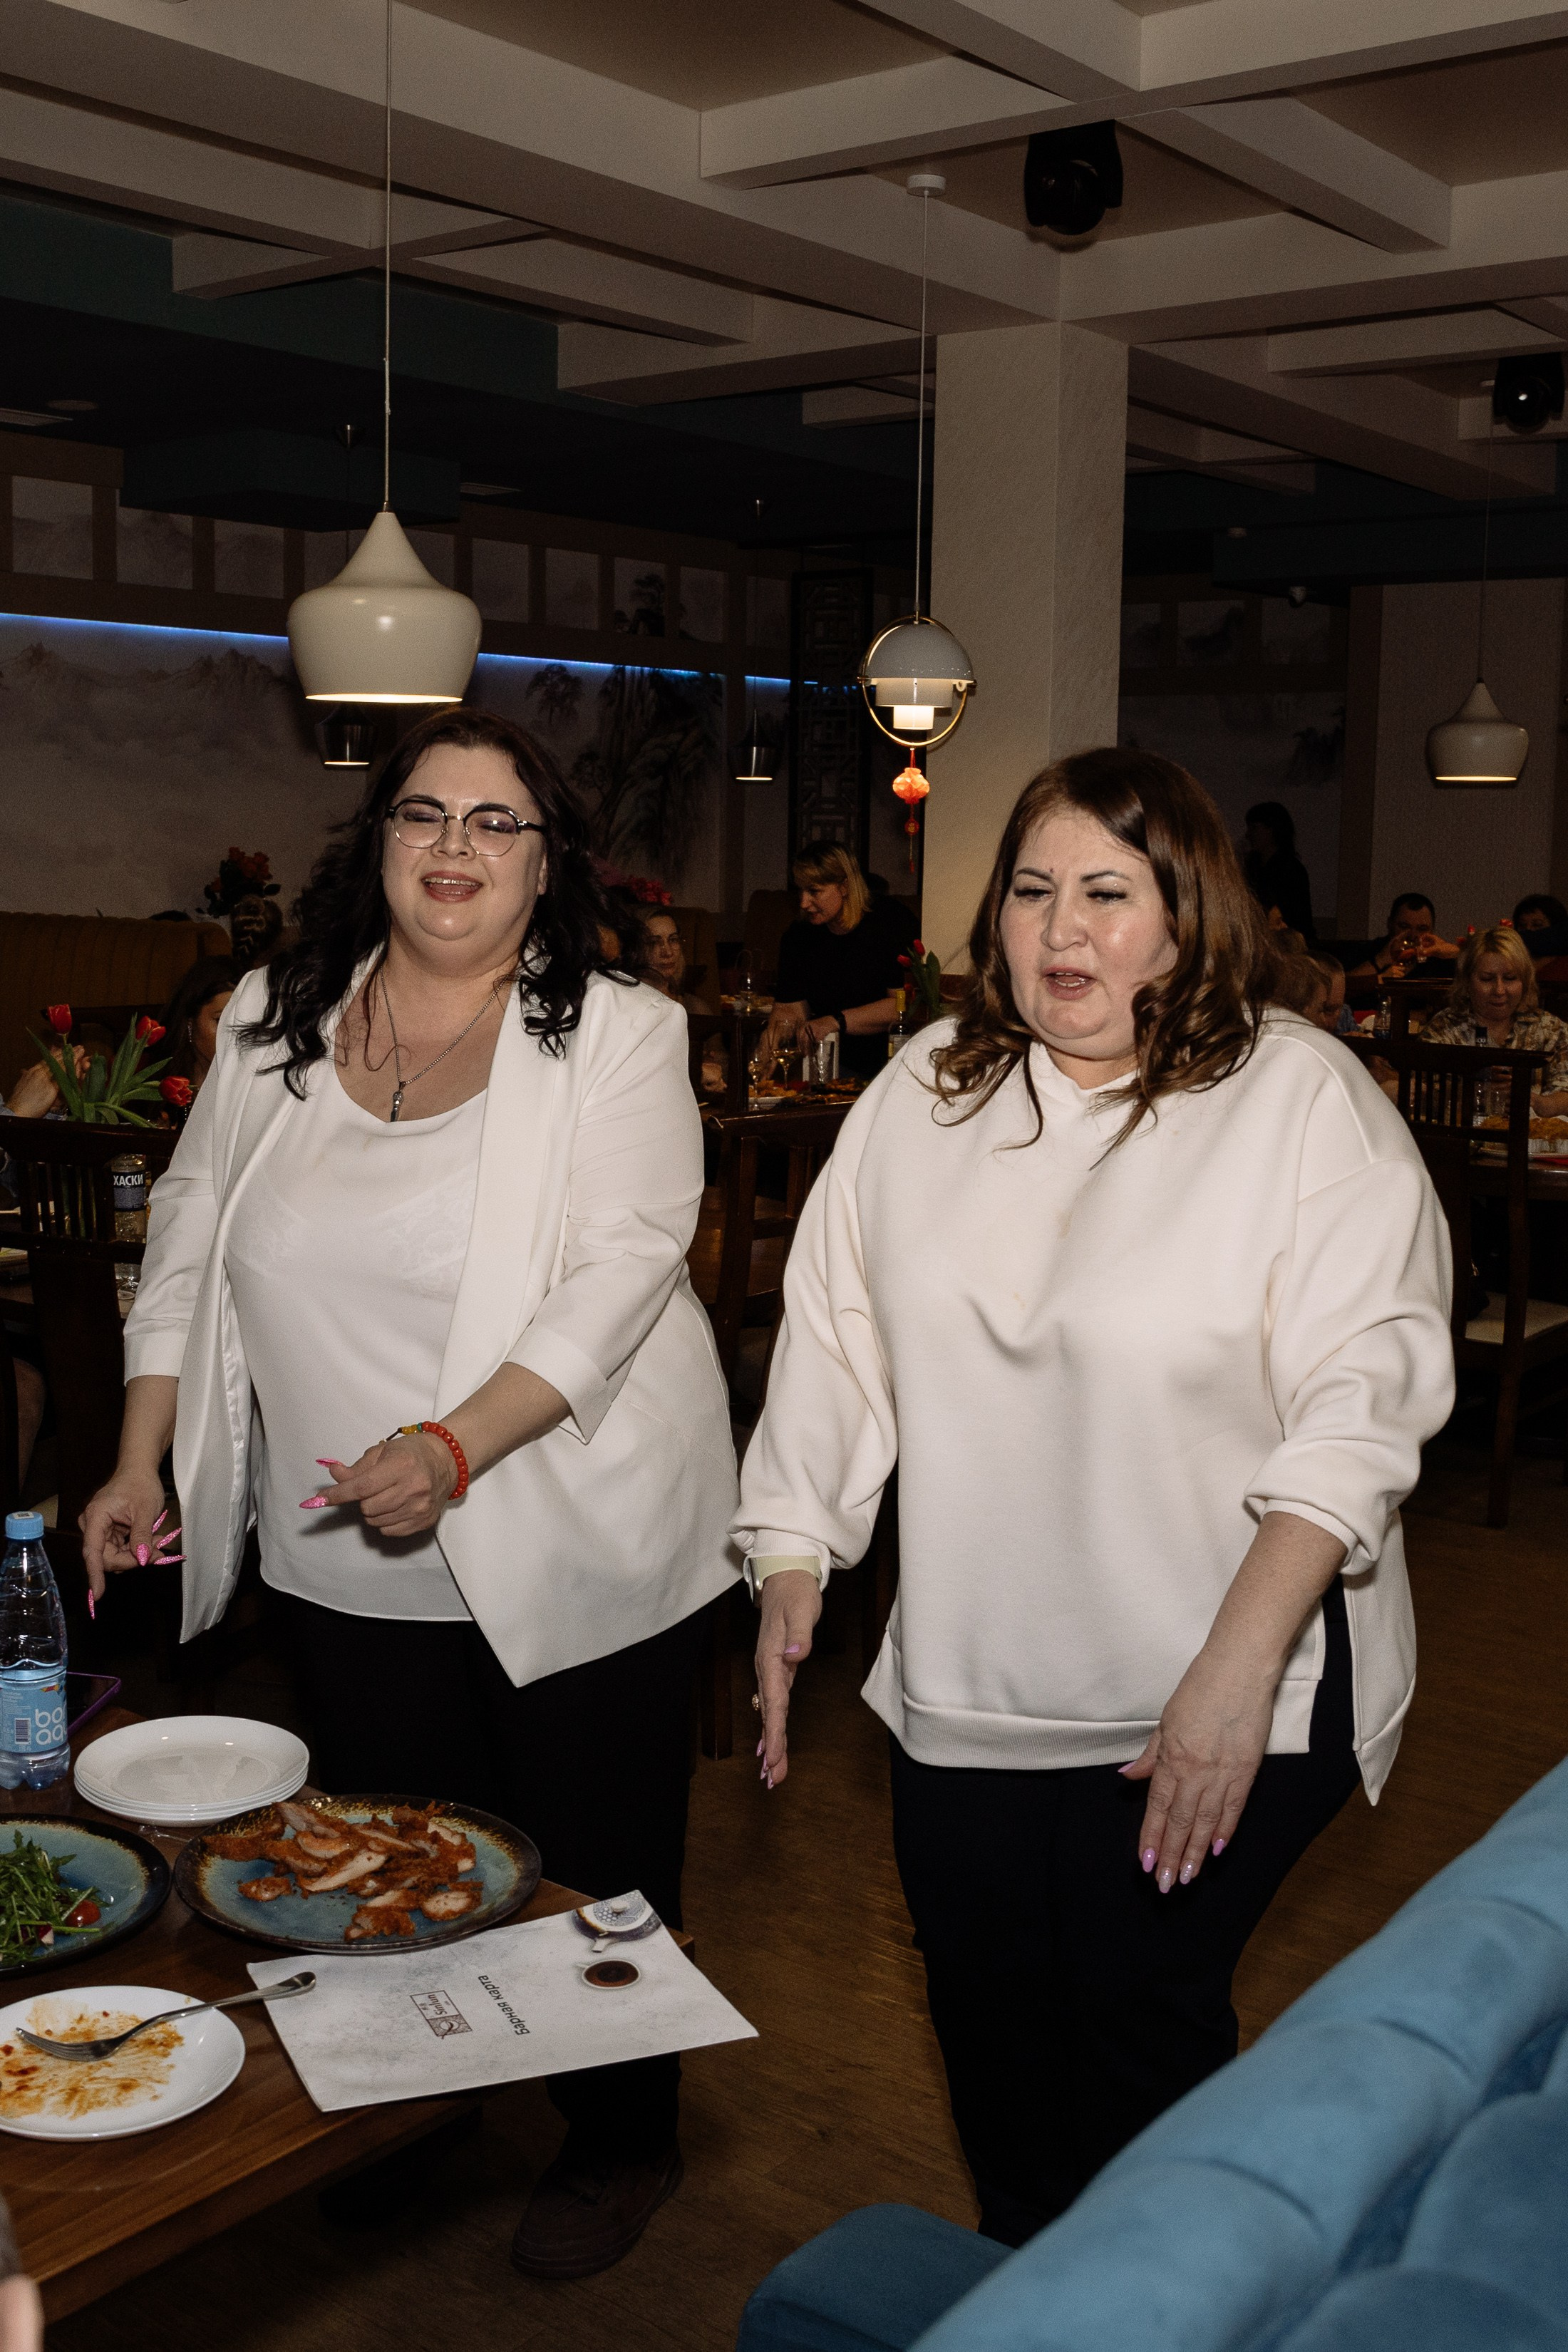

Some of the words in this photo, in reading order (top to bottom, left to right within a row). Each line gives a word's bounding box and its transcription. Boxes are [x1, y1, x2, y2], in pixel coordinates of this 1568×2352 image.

[113, 1174, 144, 1186] ХАСКИ
[478, 1975, 503, 2000] карта
[428, 1994, 448, 2016] Sinlun
[497, 2001, 530, 2035] Барная
